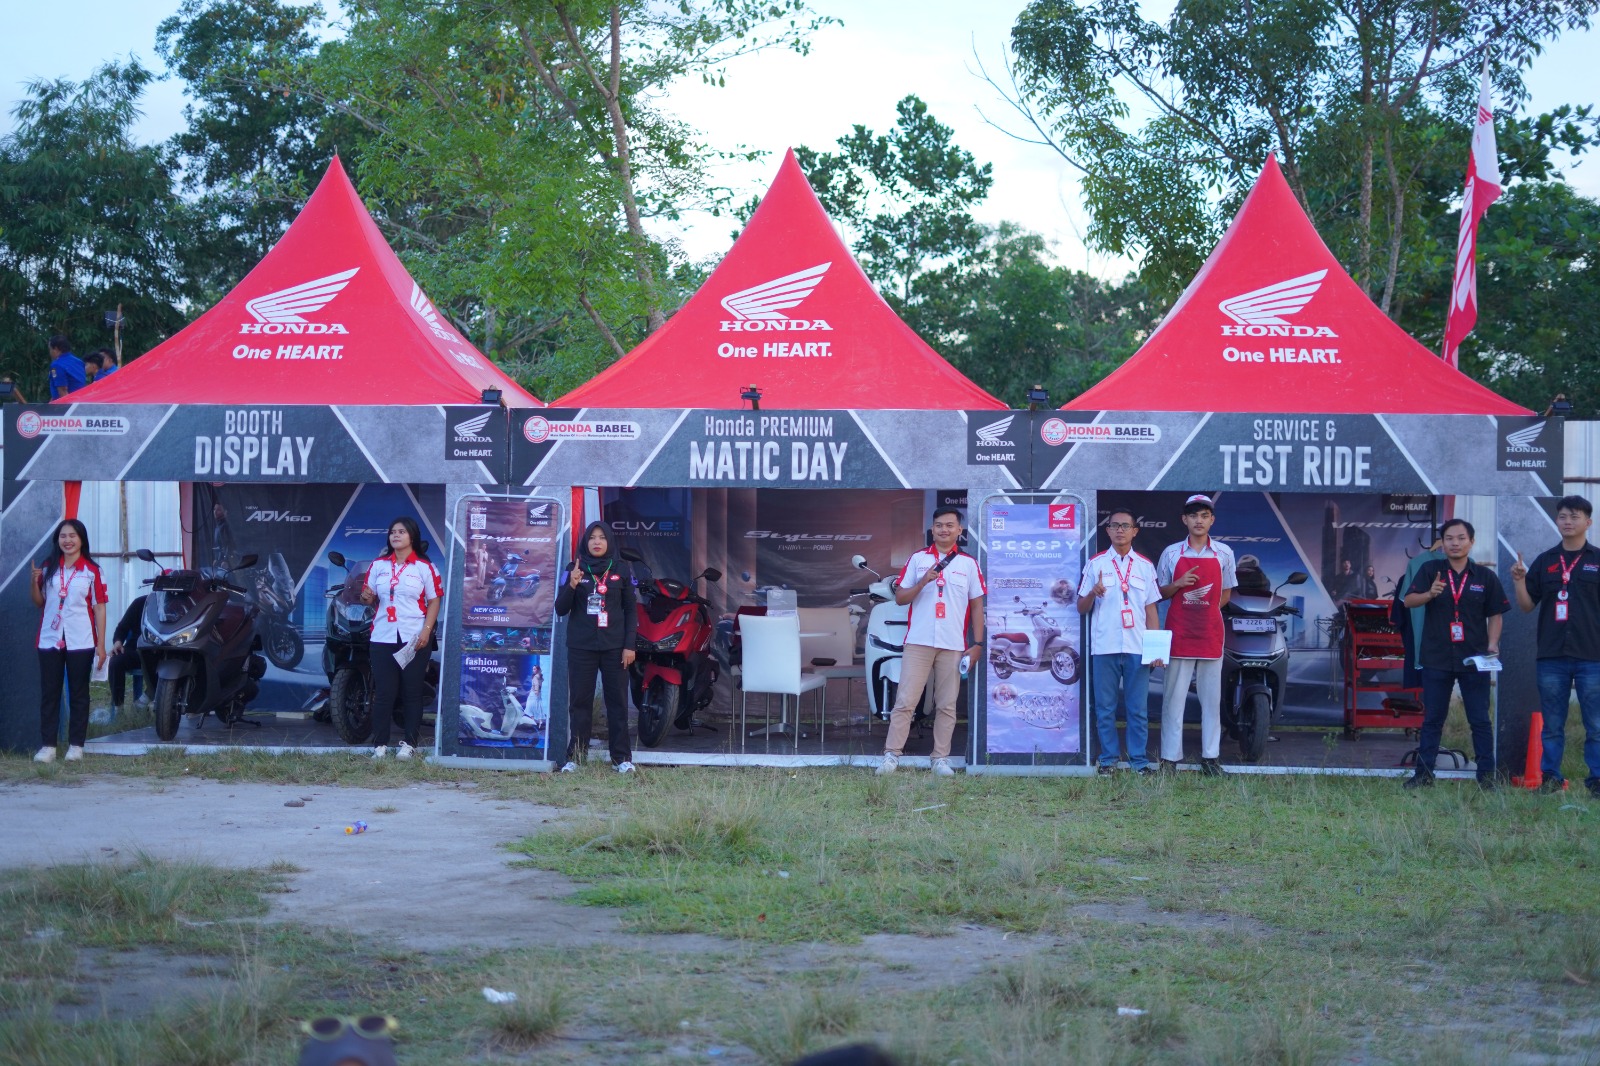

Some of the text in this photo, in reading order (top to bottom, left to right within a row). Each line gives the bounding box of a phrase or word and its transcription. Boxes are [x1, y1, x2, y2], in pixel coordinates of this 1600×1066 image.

[239, 323, 349, 334] HONDA
[719, 319, 834, 332] HONDA
[1221, 325, 1339, 338] HONDA
[232, 344, 344, 360] One HEART.
[717, 342, 832, 358] One HEART.
[1222, 347, 1342, 364] One HEART.
[42, 419, 123, 428] HONDA BABEL
[224, 410, 283, 435] BOOTH
[549, 423, 635, 433] HONDA BABEL
[705, 415, 833, 437] Honda PREMIUM
[1068, 426, 1155, 437] HONDA BABEL
[1253, 419, 1337, 441] SERVICE &
[194, 436, 315, 476] DISPLAY
[454, 449, 493, 457] One HEART.
[976, 453, 1016, 461] One HEART.
[690, 441, 848, 481] MATIC DAY
[1219, 444, 1372, 487] TEST RIDE
[1505, 459, 1547, 468] One HEART.
[1390, 503, 1404, 511] One
[991, 540, 1076, 551] SCOOPY
[465, 657, 498, 667] fashion
[480, 666, 508, 674] POWER
